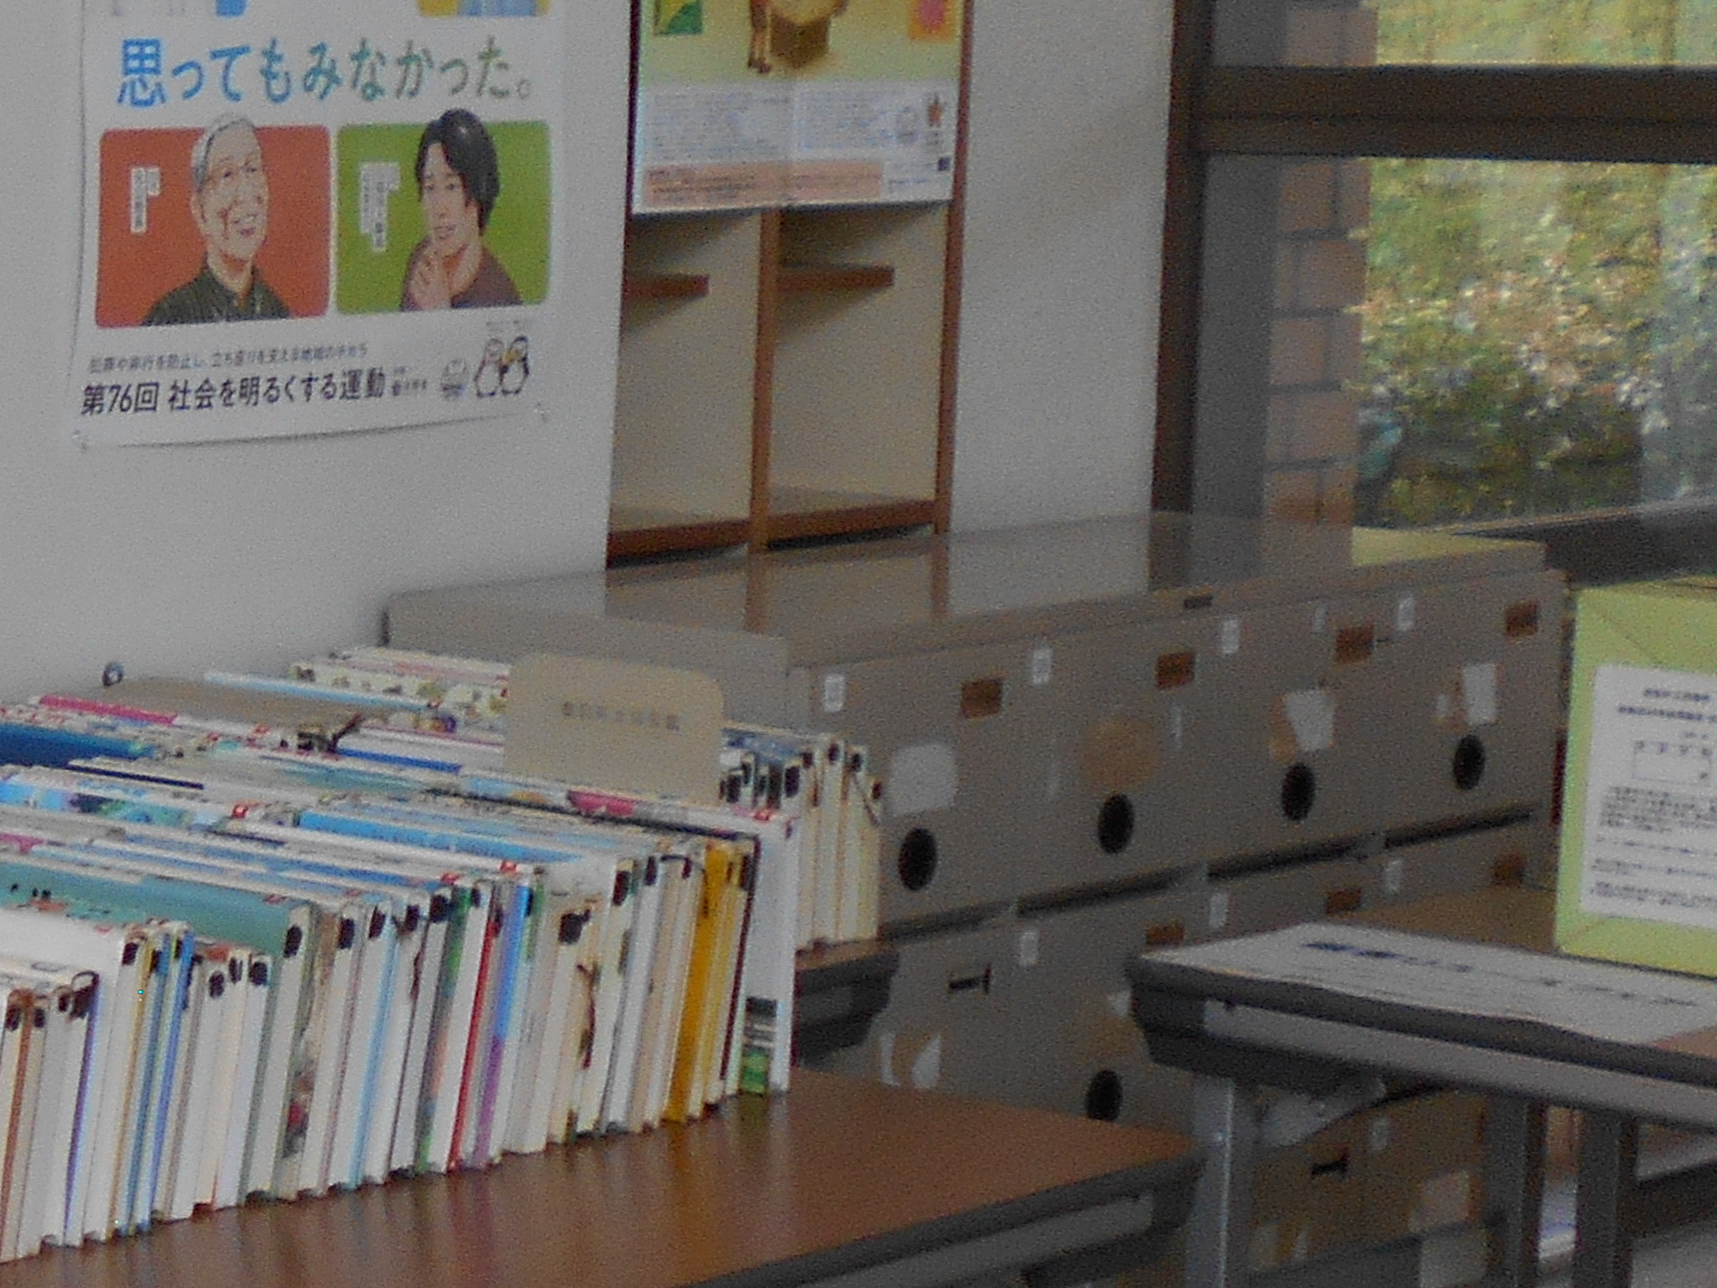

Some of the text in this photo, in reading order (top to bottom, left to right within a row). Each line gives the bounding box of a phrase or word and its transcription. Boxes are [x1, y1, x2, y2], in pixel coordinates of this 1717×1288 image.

[117, 35, 533, 108] 思ってもみなかった。
[80, 380, 161, 417] 第76回
[167, 368, 387, 412] 社会を明るくする運動
